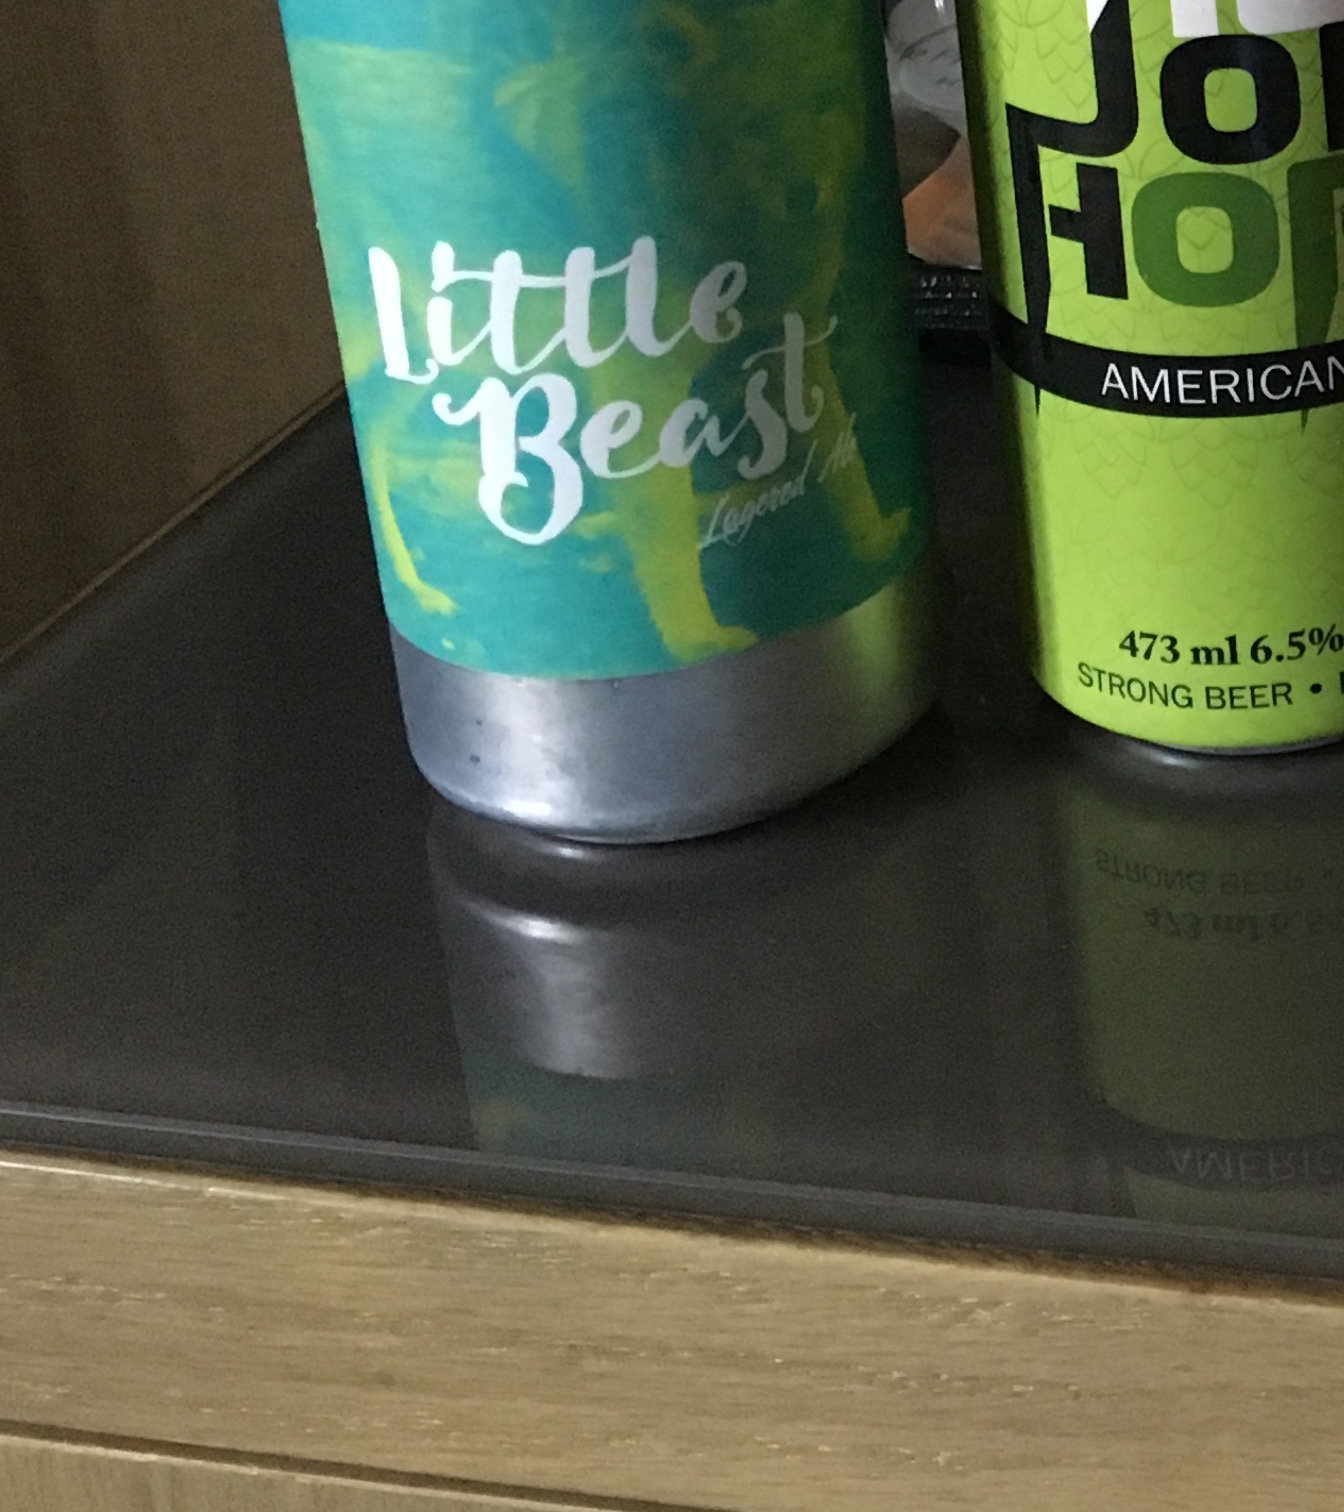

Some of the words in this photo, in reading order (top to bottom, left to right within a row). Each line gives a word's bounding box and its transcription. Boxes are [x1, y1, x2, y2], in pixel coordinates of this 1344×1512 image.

[368, 235, 748, 384] Little
[432, 312, 838, 545] Beast
[1077, 662, 1194, 710] STRONG
[1205, 682, 1294, 710] BEER
[1118, 629, 1180, 664] 473
[1190, 635, 1240, 665] ml
[1250, 627, 1344, 664] 6.5%
